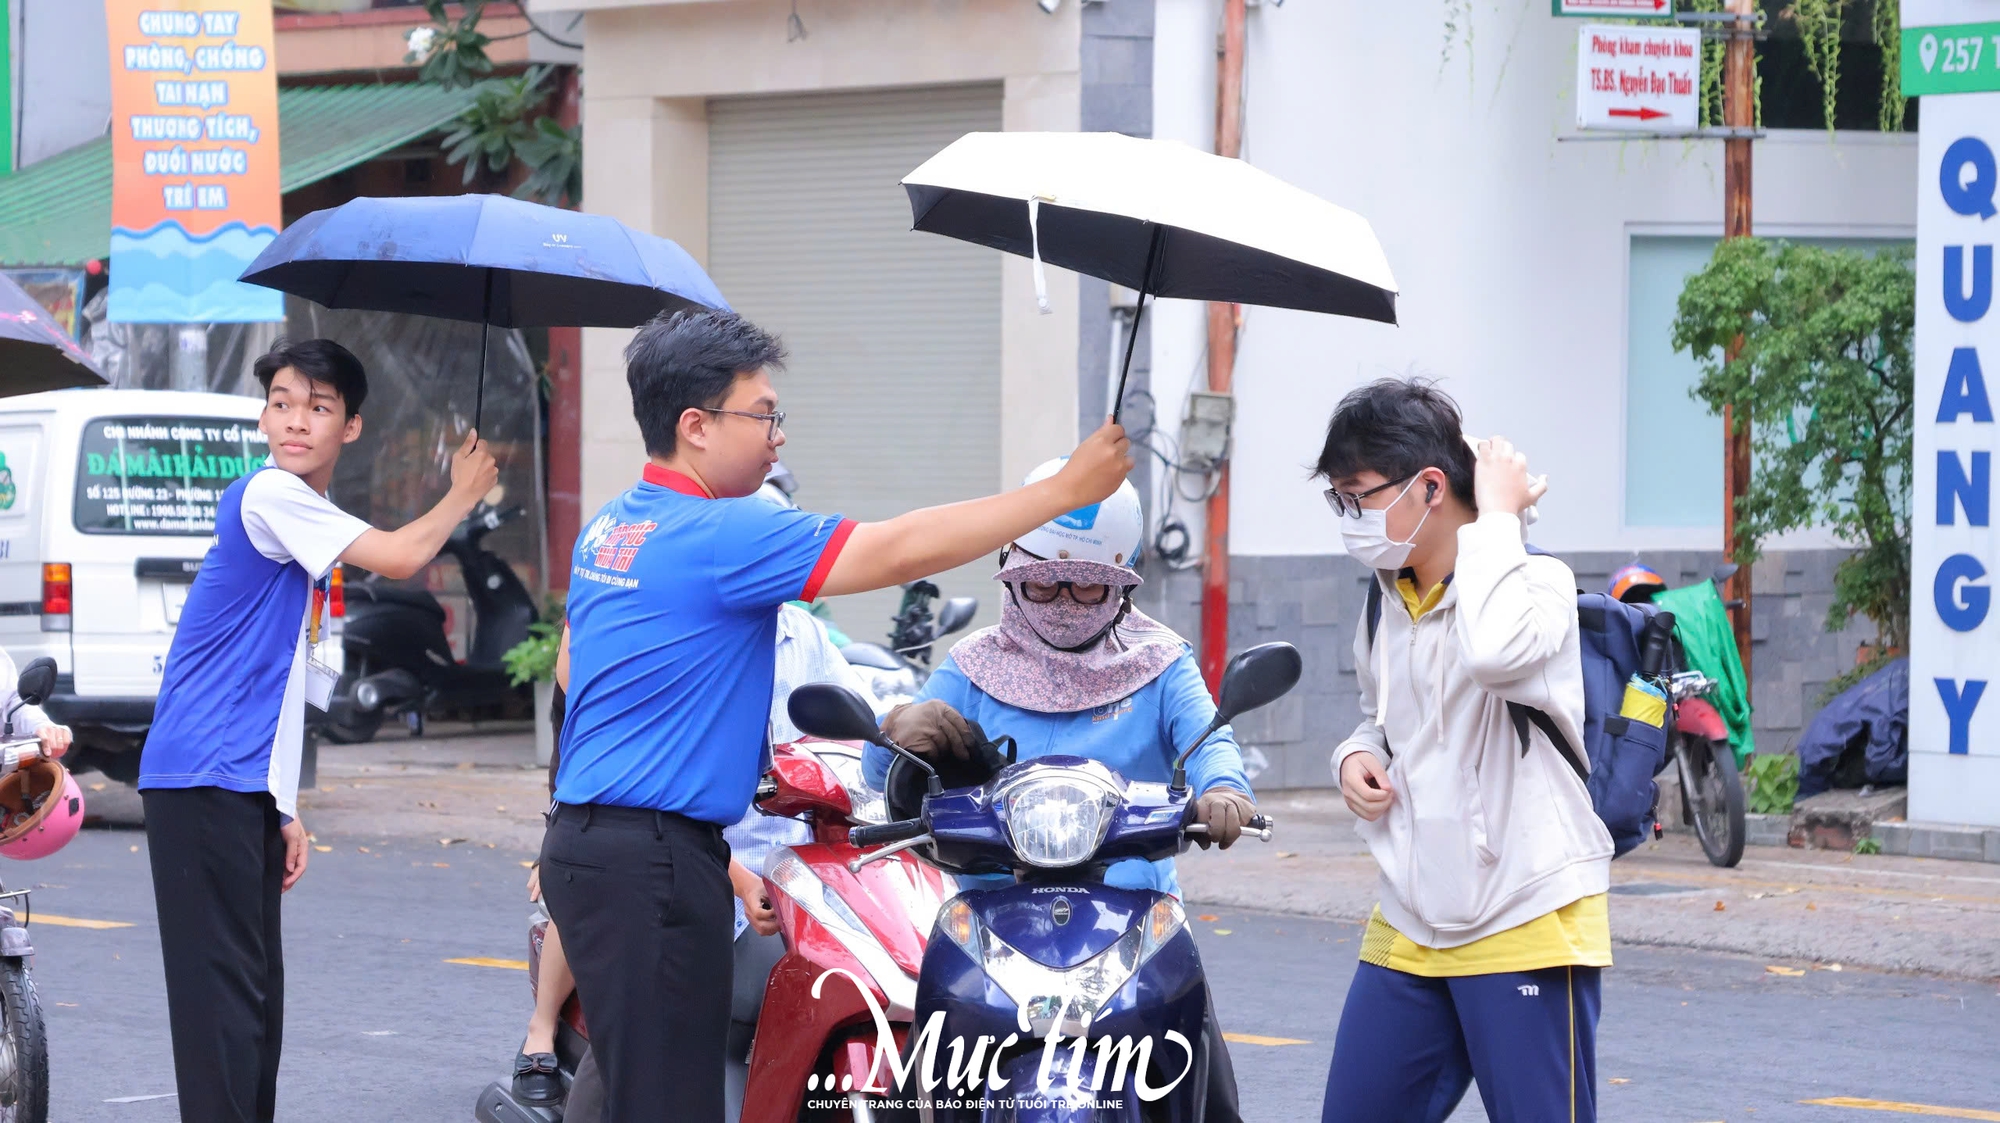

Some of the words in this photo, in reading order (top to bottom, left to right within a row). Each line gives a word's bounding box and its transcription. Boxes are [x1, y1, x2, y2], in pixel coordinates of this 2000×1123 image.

[139, 11, 199, 36] CHUNG
[202, 11, 239, 36] TAY
[124, 41, 193, 75] PHÒNG,
[195, 40, 266, 70] CHỐNG
[1942, 36, 1984, 73] 257
[155, 81, 183, 105] TAI
[184, 81, 228, 110] NẠN
[205, 112, 259, 144] TÍCH,
[197, 185, 228, 210] EM
[1934, 136, 1997, 632] QUANG
[205, 428, 221, 441] TY
[1933, 677, 1988, 755] Y
[1031, 886, 1091, 895] HONDA
